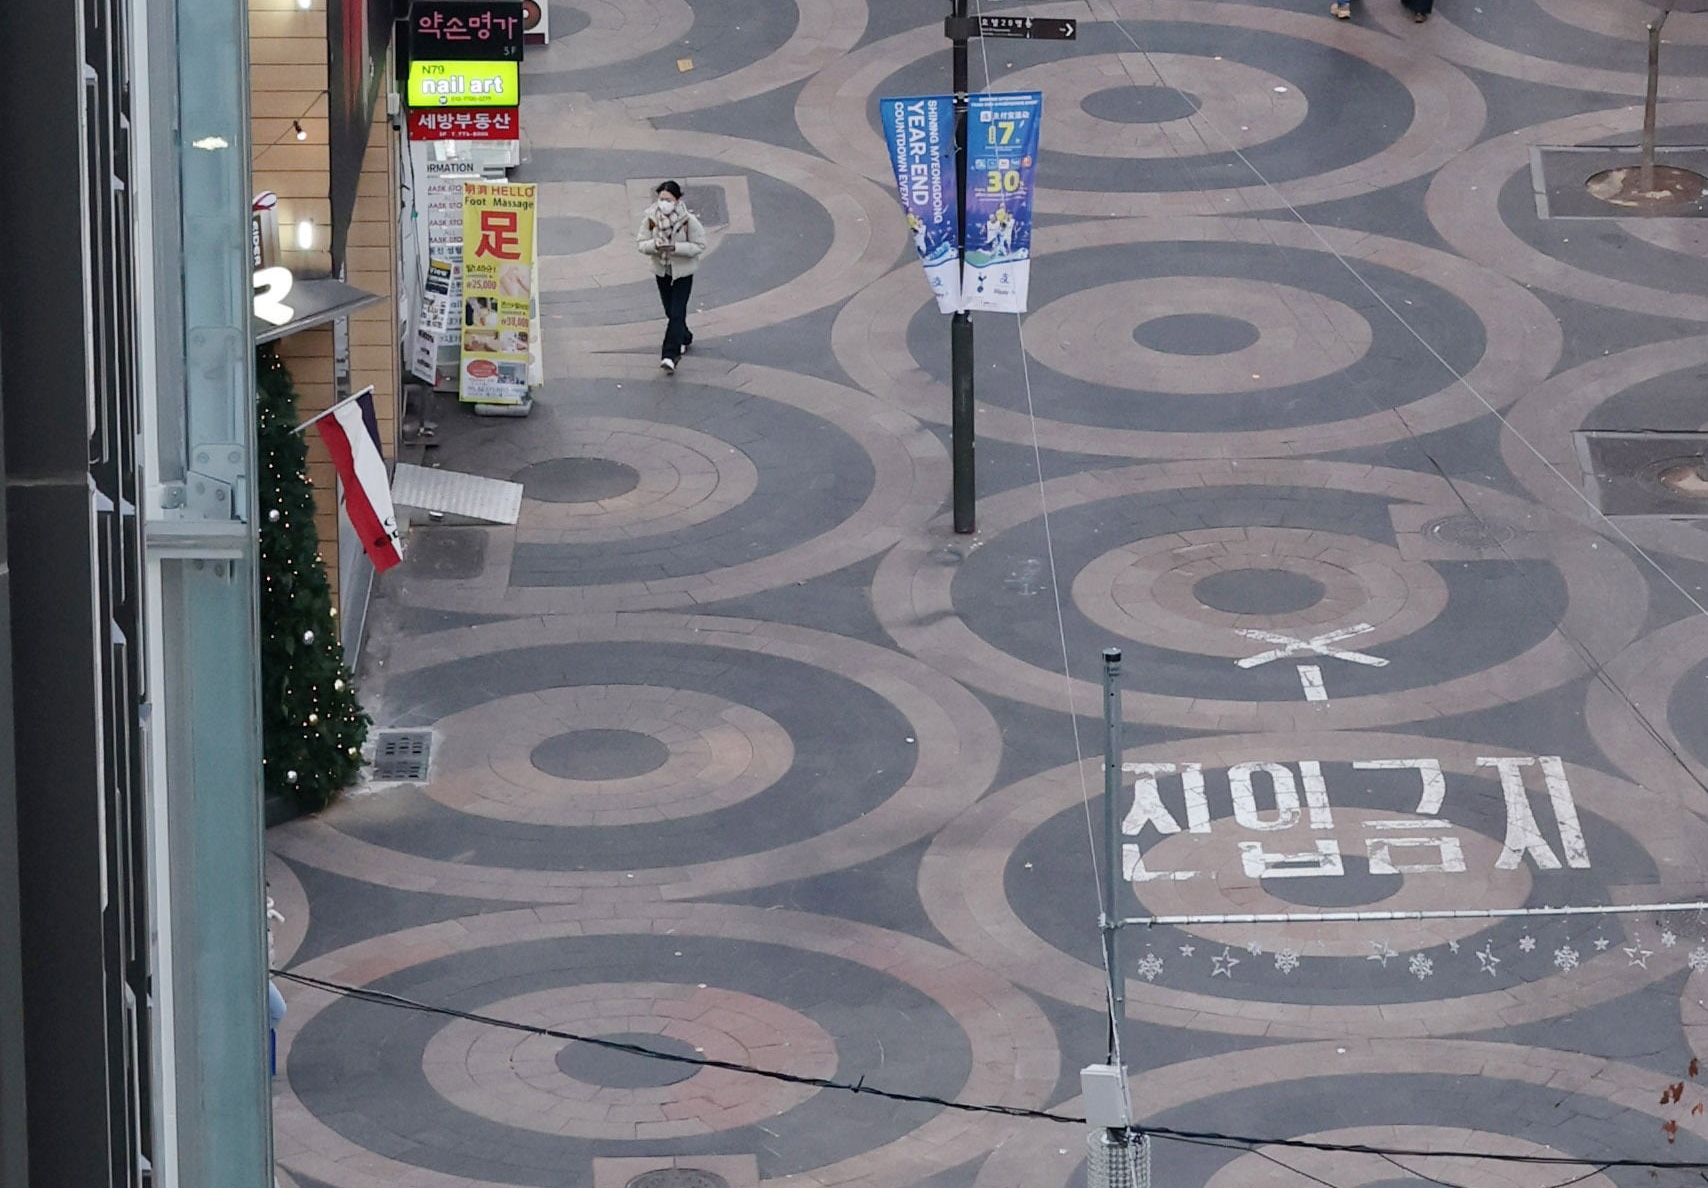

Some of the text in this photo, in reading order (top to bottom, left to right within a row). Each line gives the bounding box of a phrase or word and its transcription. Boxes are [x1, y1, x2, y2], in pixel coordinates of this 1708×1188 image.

[418, 11, 518, 40] 약손명가
[421, 76, 504, 94] nail art
[418, 113, 511, 130] 세방부동산
[894, 101, 908, 176] COUNTDOWN
[907, 100, 929, 206] YEAR-END
[928, 100, 943, 225] SHINING MYEONGDONG
[491, 186, 535, 197] HELLO
[987, 170, 1020, 193] 30
[464, 196, 534, 210] Foot Massage
[475, 210, 521, 261] 足
